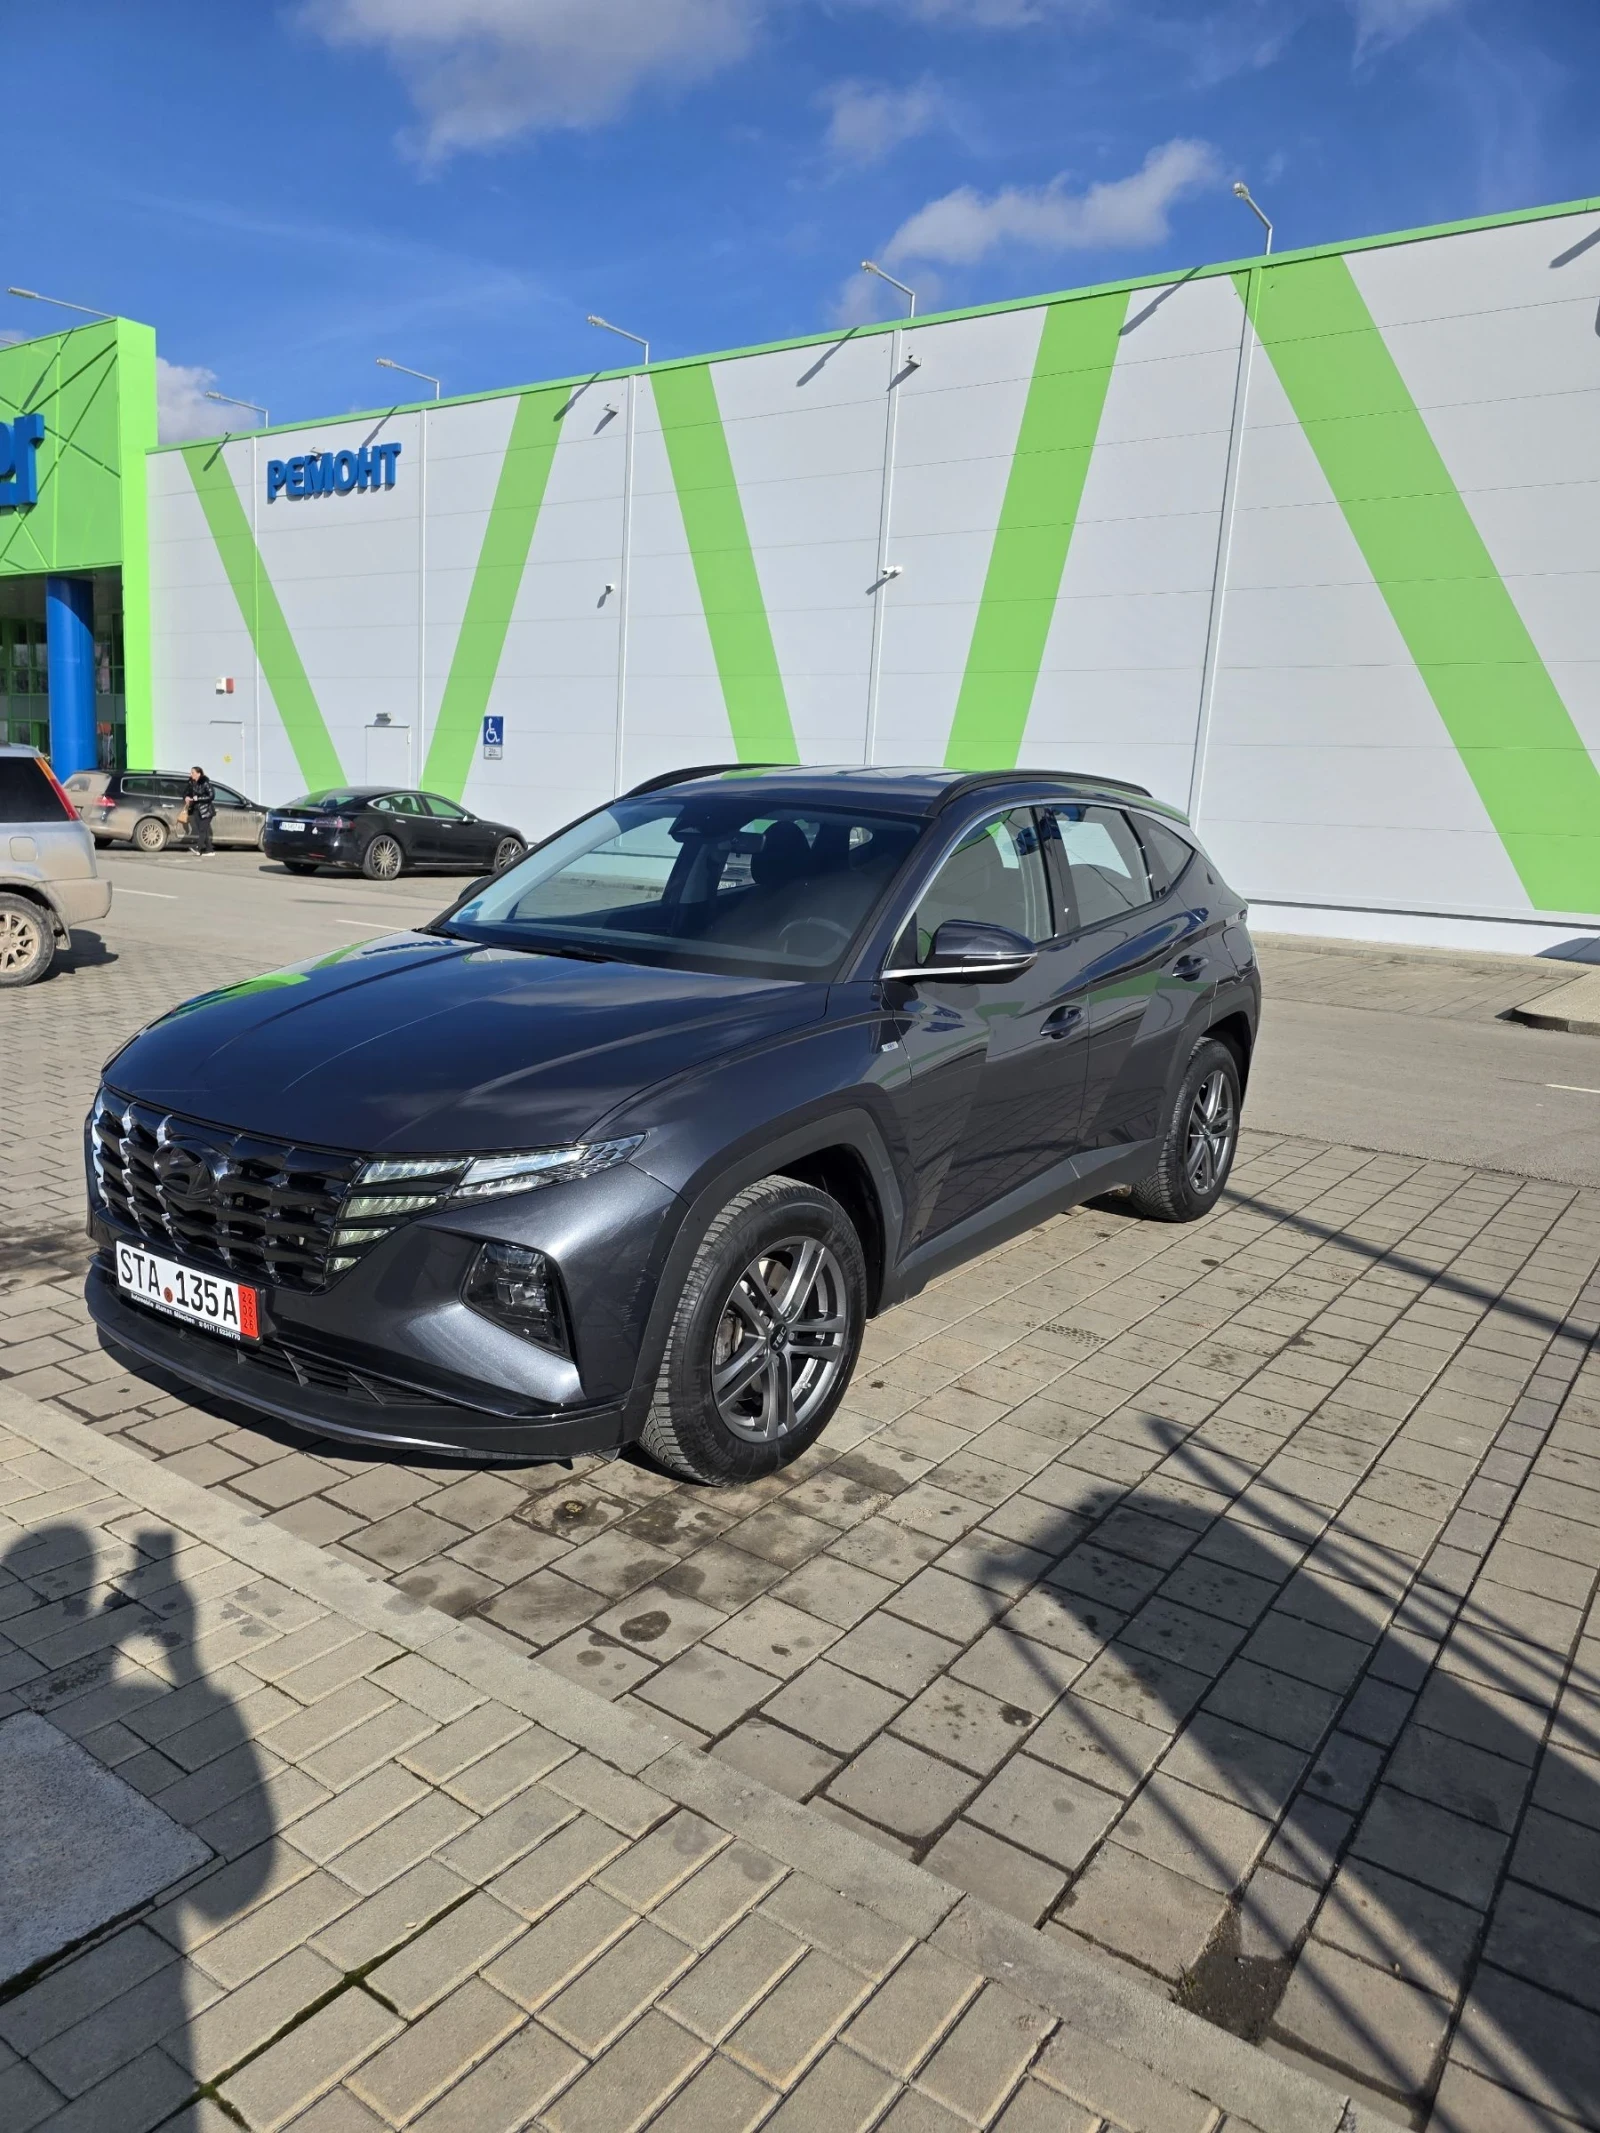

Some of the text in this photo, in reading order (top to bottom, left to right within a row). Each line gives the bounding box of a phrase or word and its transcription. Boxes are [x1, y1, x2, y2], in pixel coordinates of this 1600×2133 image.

[267, 442, 402, 503] РЕМОНТ
[120, 1248, 238, 1325] STA 135A
[241, 1291, 253, 1305] 22
[242, 1305, 254, 1318] 02
[243, 1317, 254, 1331] 26
[772, 1326, 787, 1348] TEC
